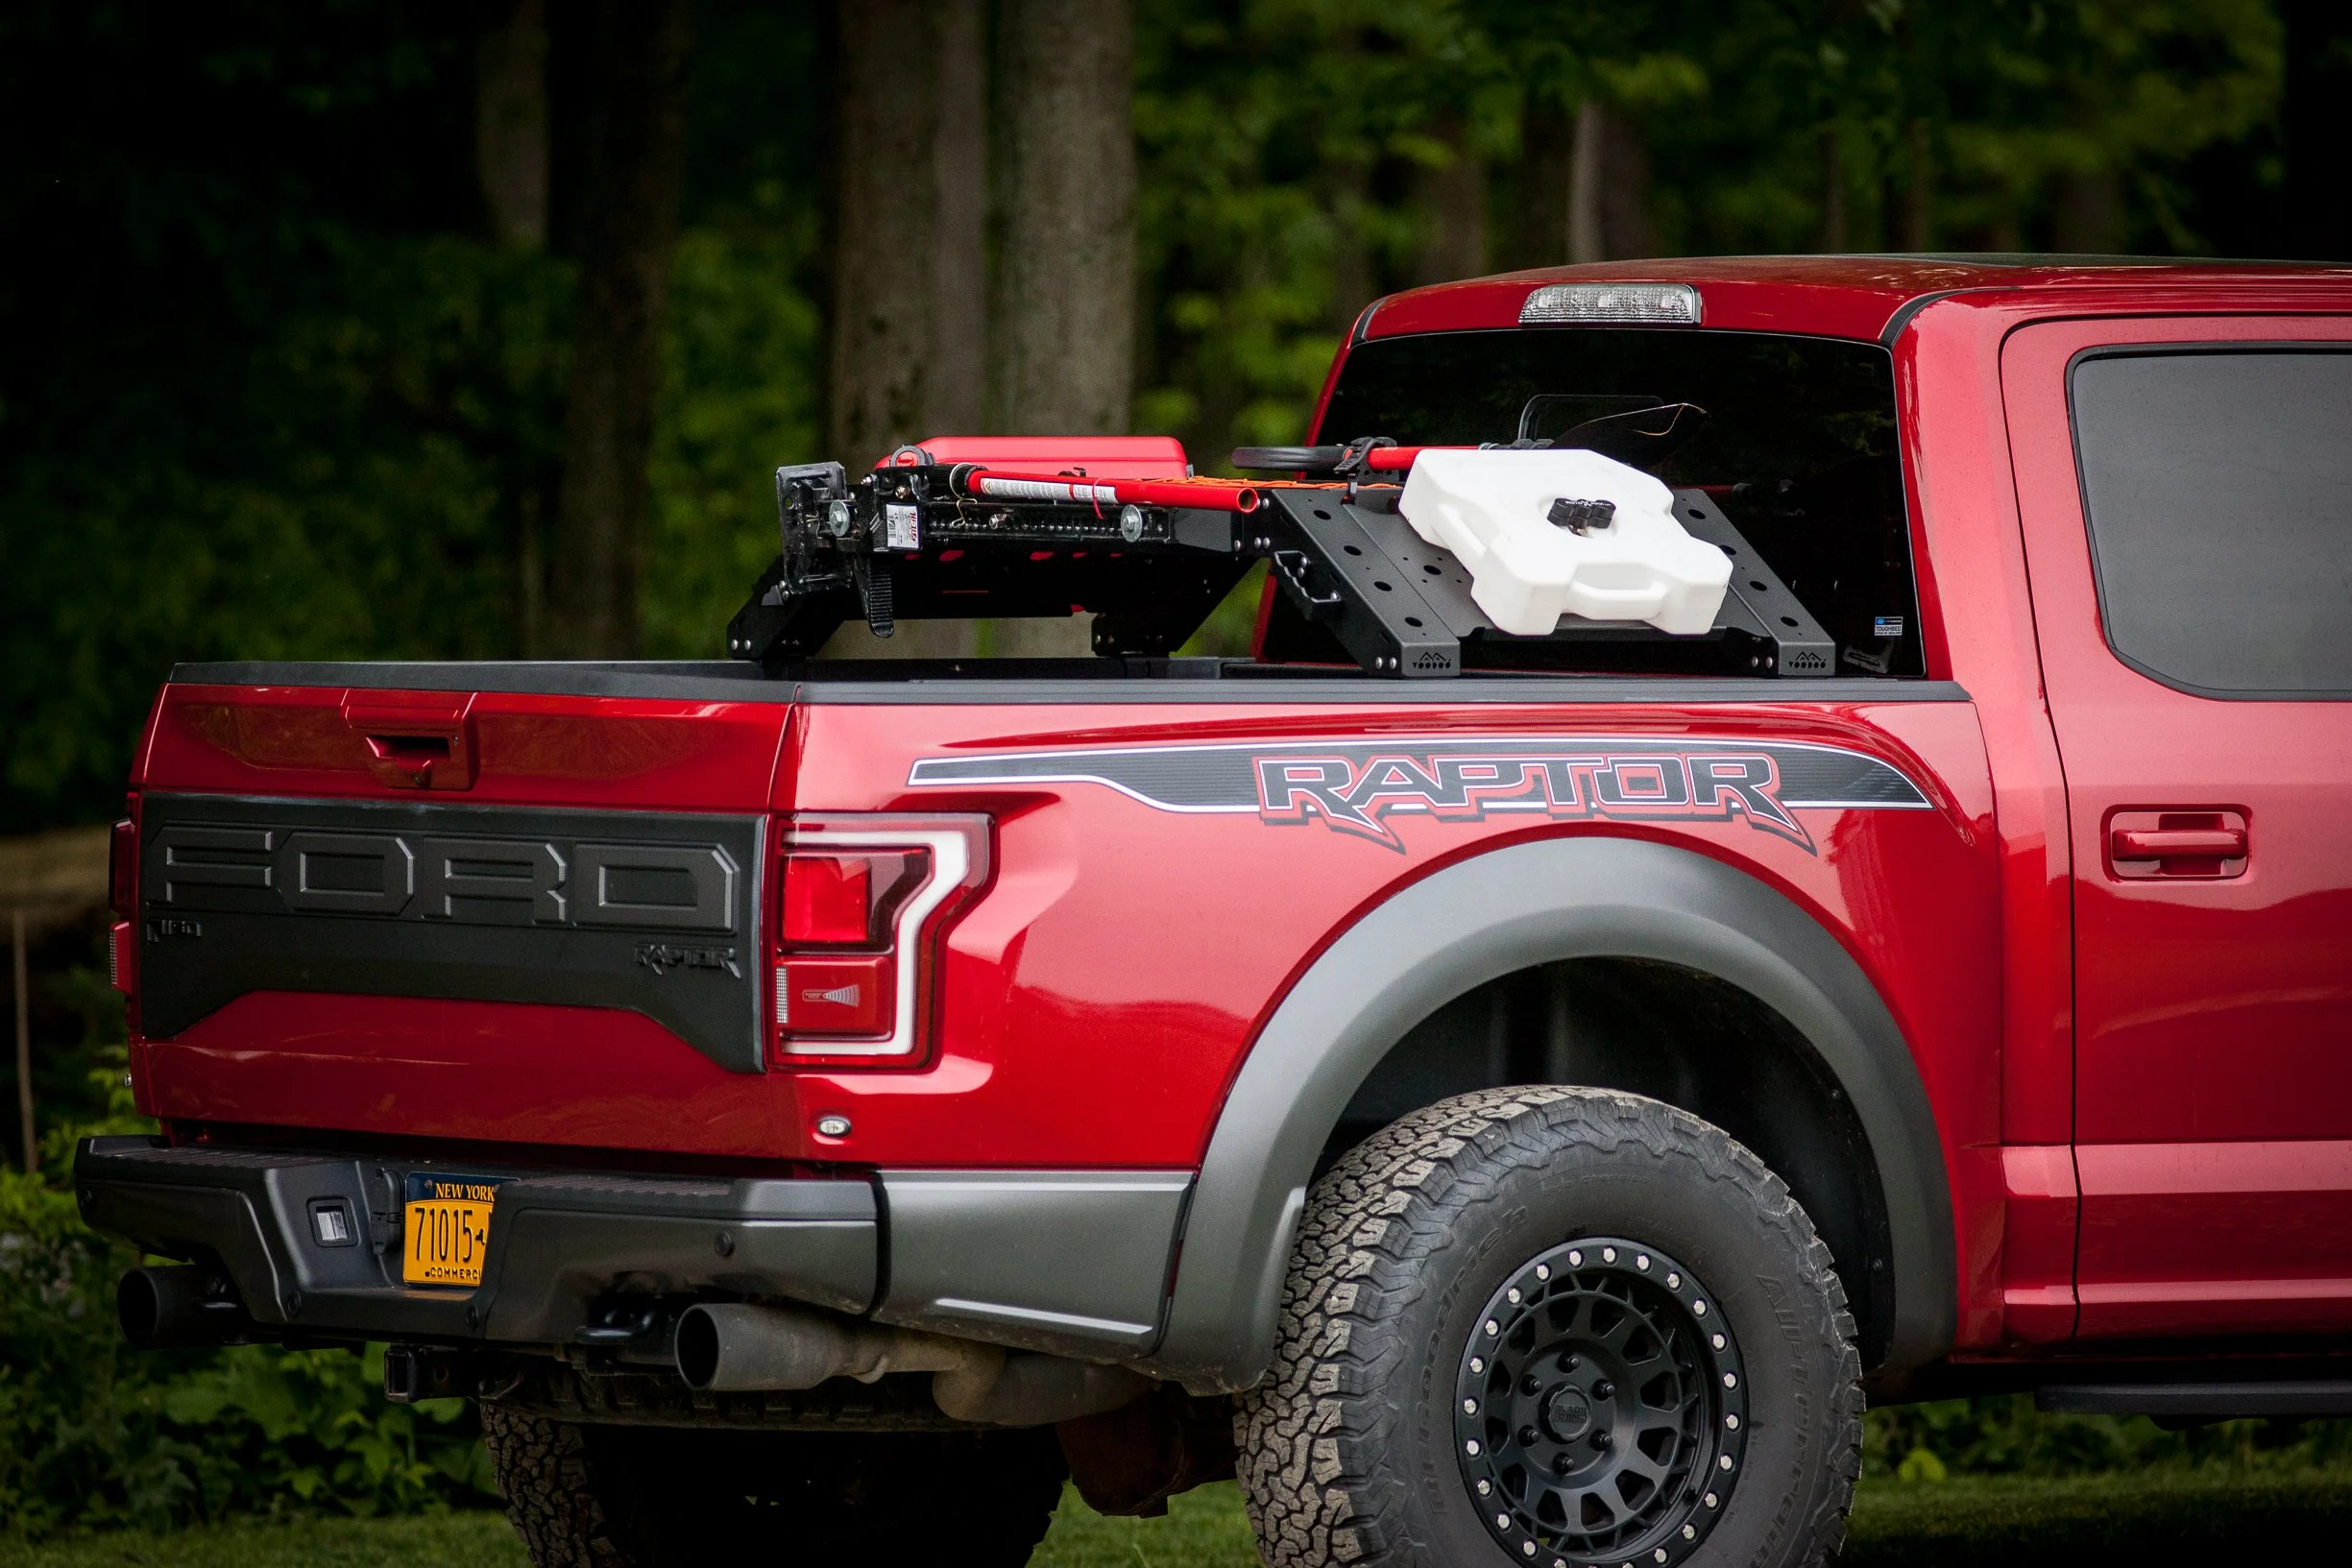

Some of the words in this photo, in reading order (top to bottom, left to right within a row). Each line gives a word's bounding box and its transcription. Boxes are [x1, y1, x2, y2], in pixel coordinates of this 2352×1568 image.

[1413, 659, 1451, 669] VOODOO
[1788, 659, 1827, 669] VOODOO
[1252, 753, 1817, 856] RAPTOR
[149, 823, 740, 935] FORD
[435, 1182, 463, 1199] NEW
[466, 1184, 495, 1202] YORK
[415, 1207, 473, 1264] 71015
[430, 1267, 481, 1280] COMMERCI
